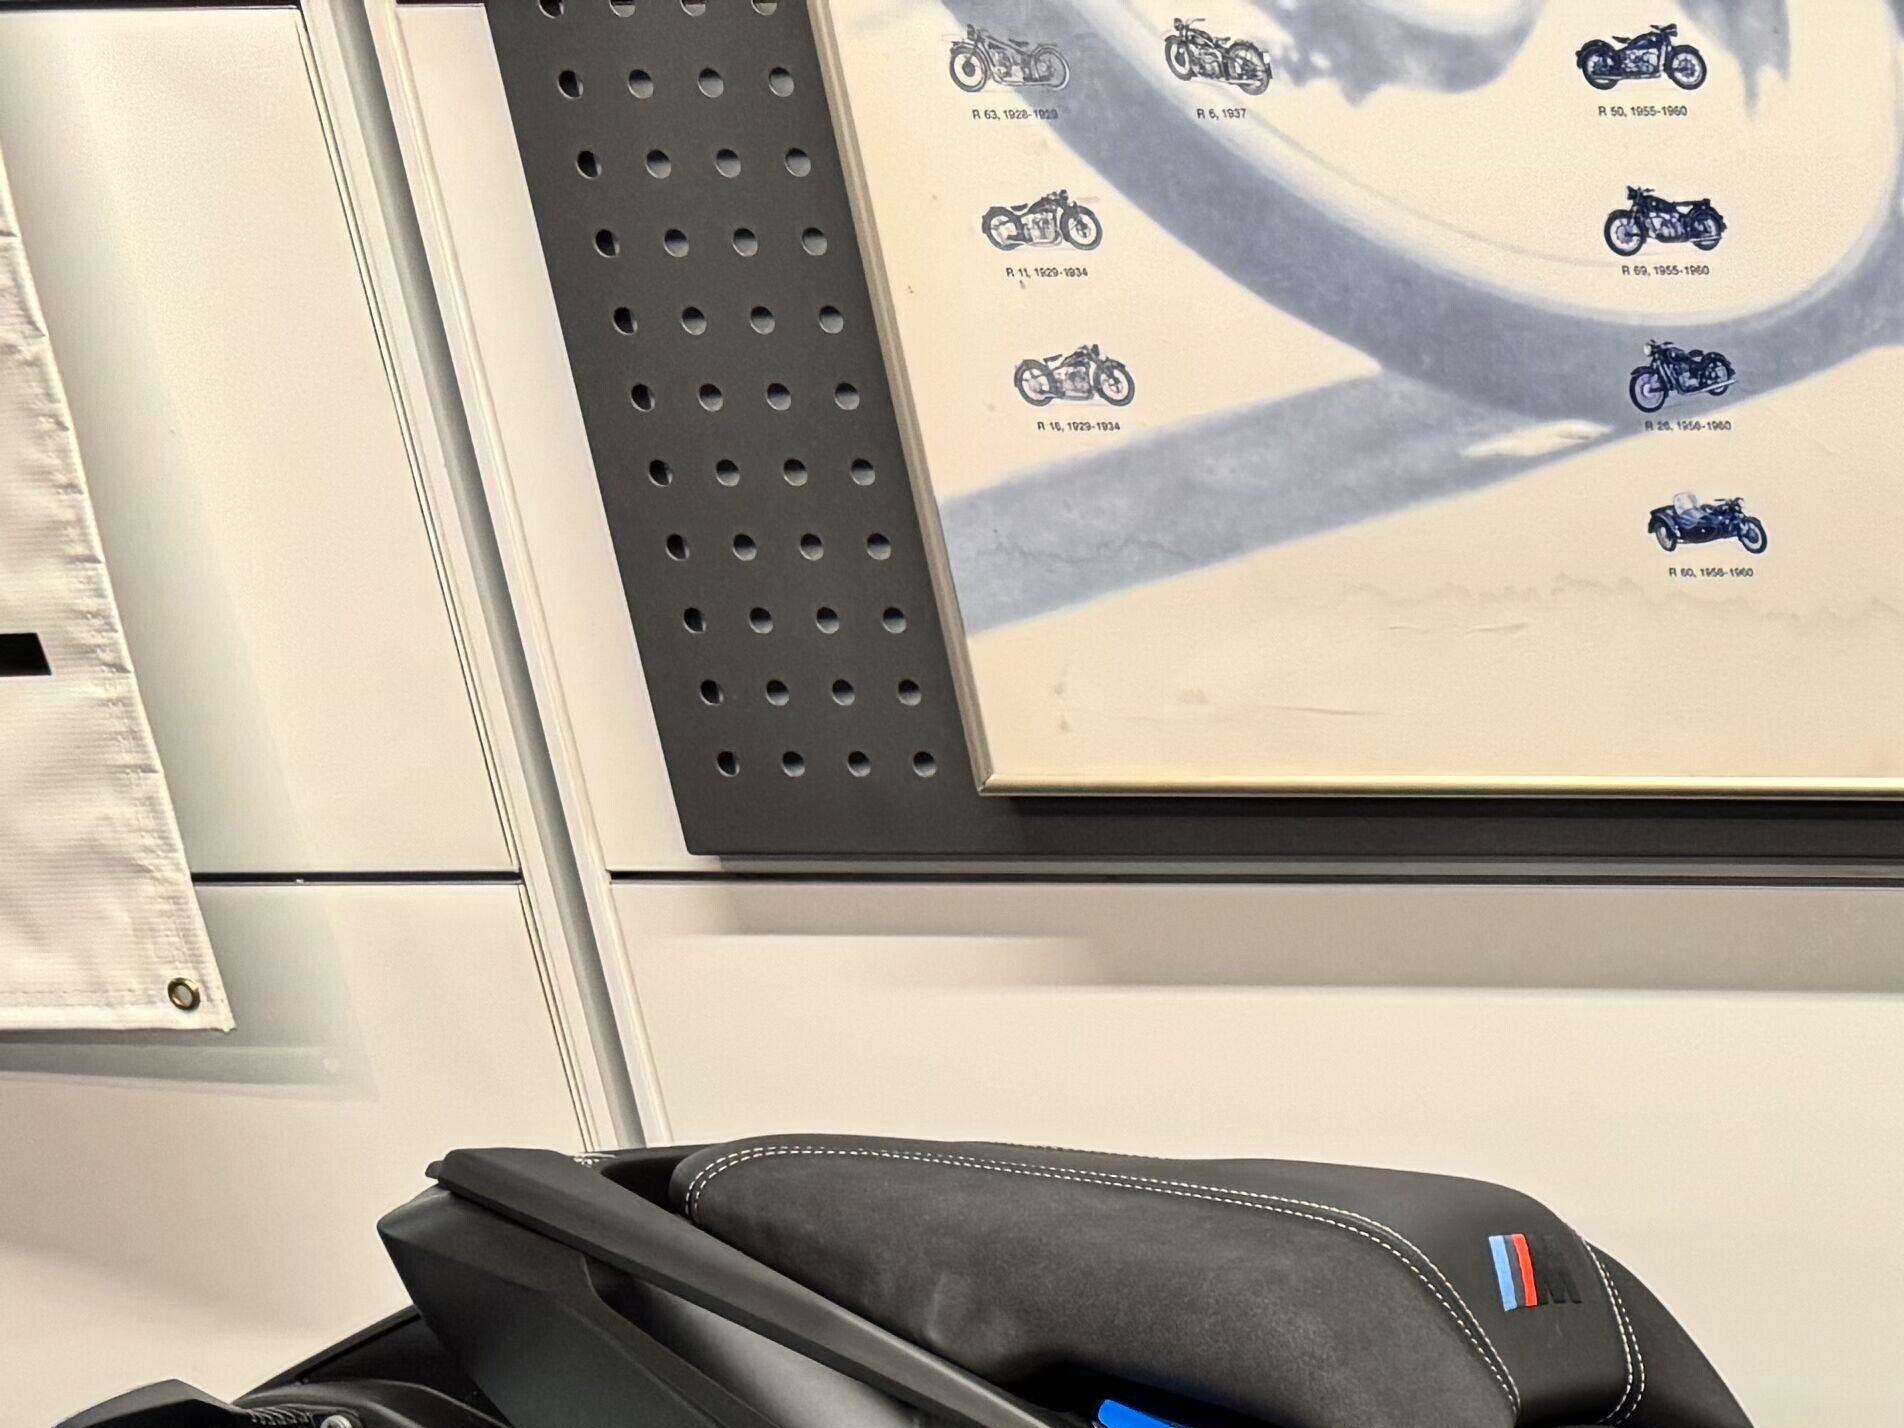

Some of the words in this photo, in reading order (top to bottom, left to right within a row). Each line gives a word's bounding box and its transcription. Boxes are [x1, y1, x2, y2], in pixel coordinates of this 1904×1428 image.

[971, 108, 982, 121] R
[1195, 107, 1206, 120] R
[1207, 107, 1220, 121] 6,
[1597, 105, 1608, 117] R
[1005, 266, 1015, 278] R
[1621, 264, 1631, 276] R
[1036, 420, 1046, 432] R
[1644, 419, 1654, 431] R
[1668, 567, 1678, 577] R
